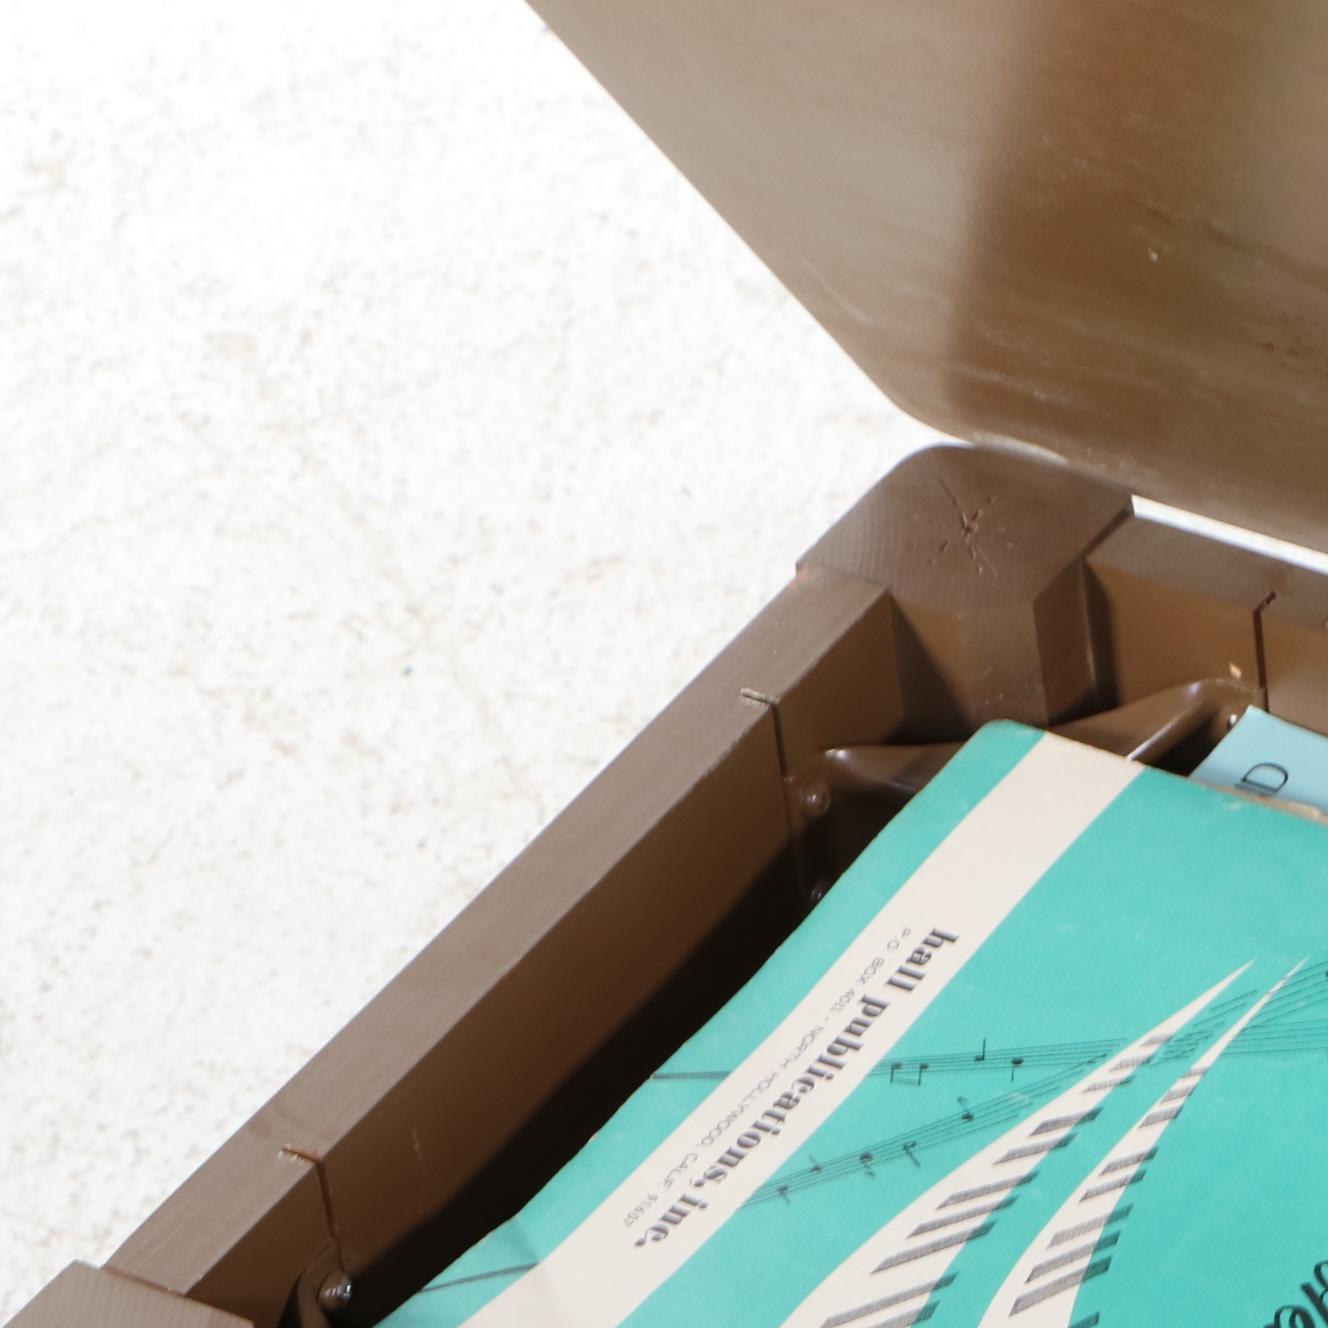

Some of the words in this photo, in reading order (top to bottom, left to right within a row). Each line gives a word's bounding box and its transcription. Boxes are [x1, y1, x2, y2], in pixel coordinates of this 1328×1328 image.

[858, 956, 886, 985] BOX
[885, 927, 960, 992] hall
[778, 1023, 824, 1068] NORTH
[689, 994, 890, 1188] publications,
[634, 1192, 708, 1247] inc.
